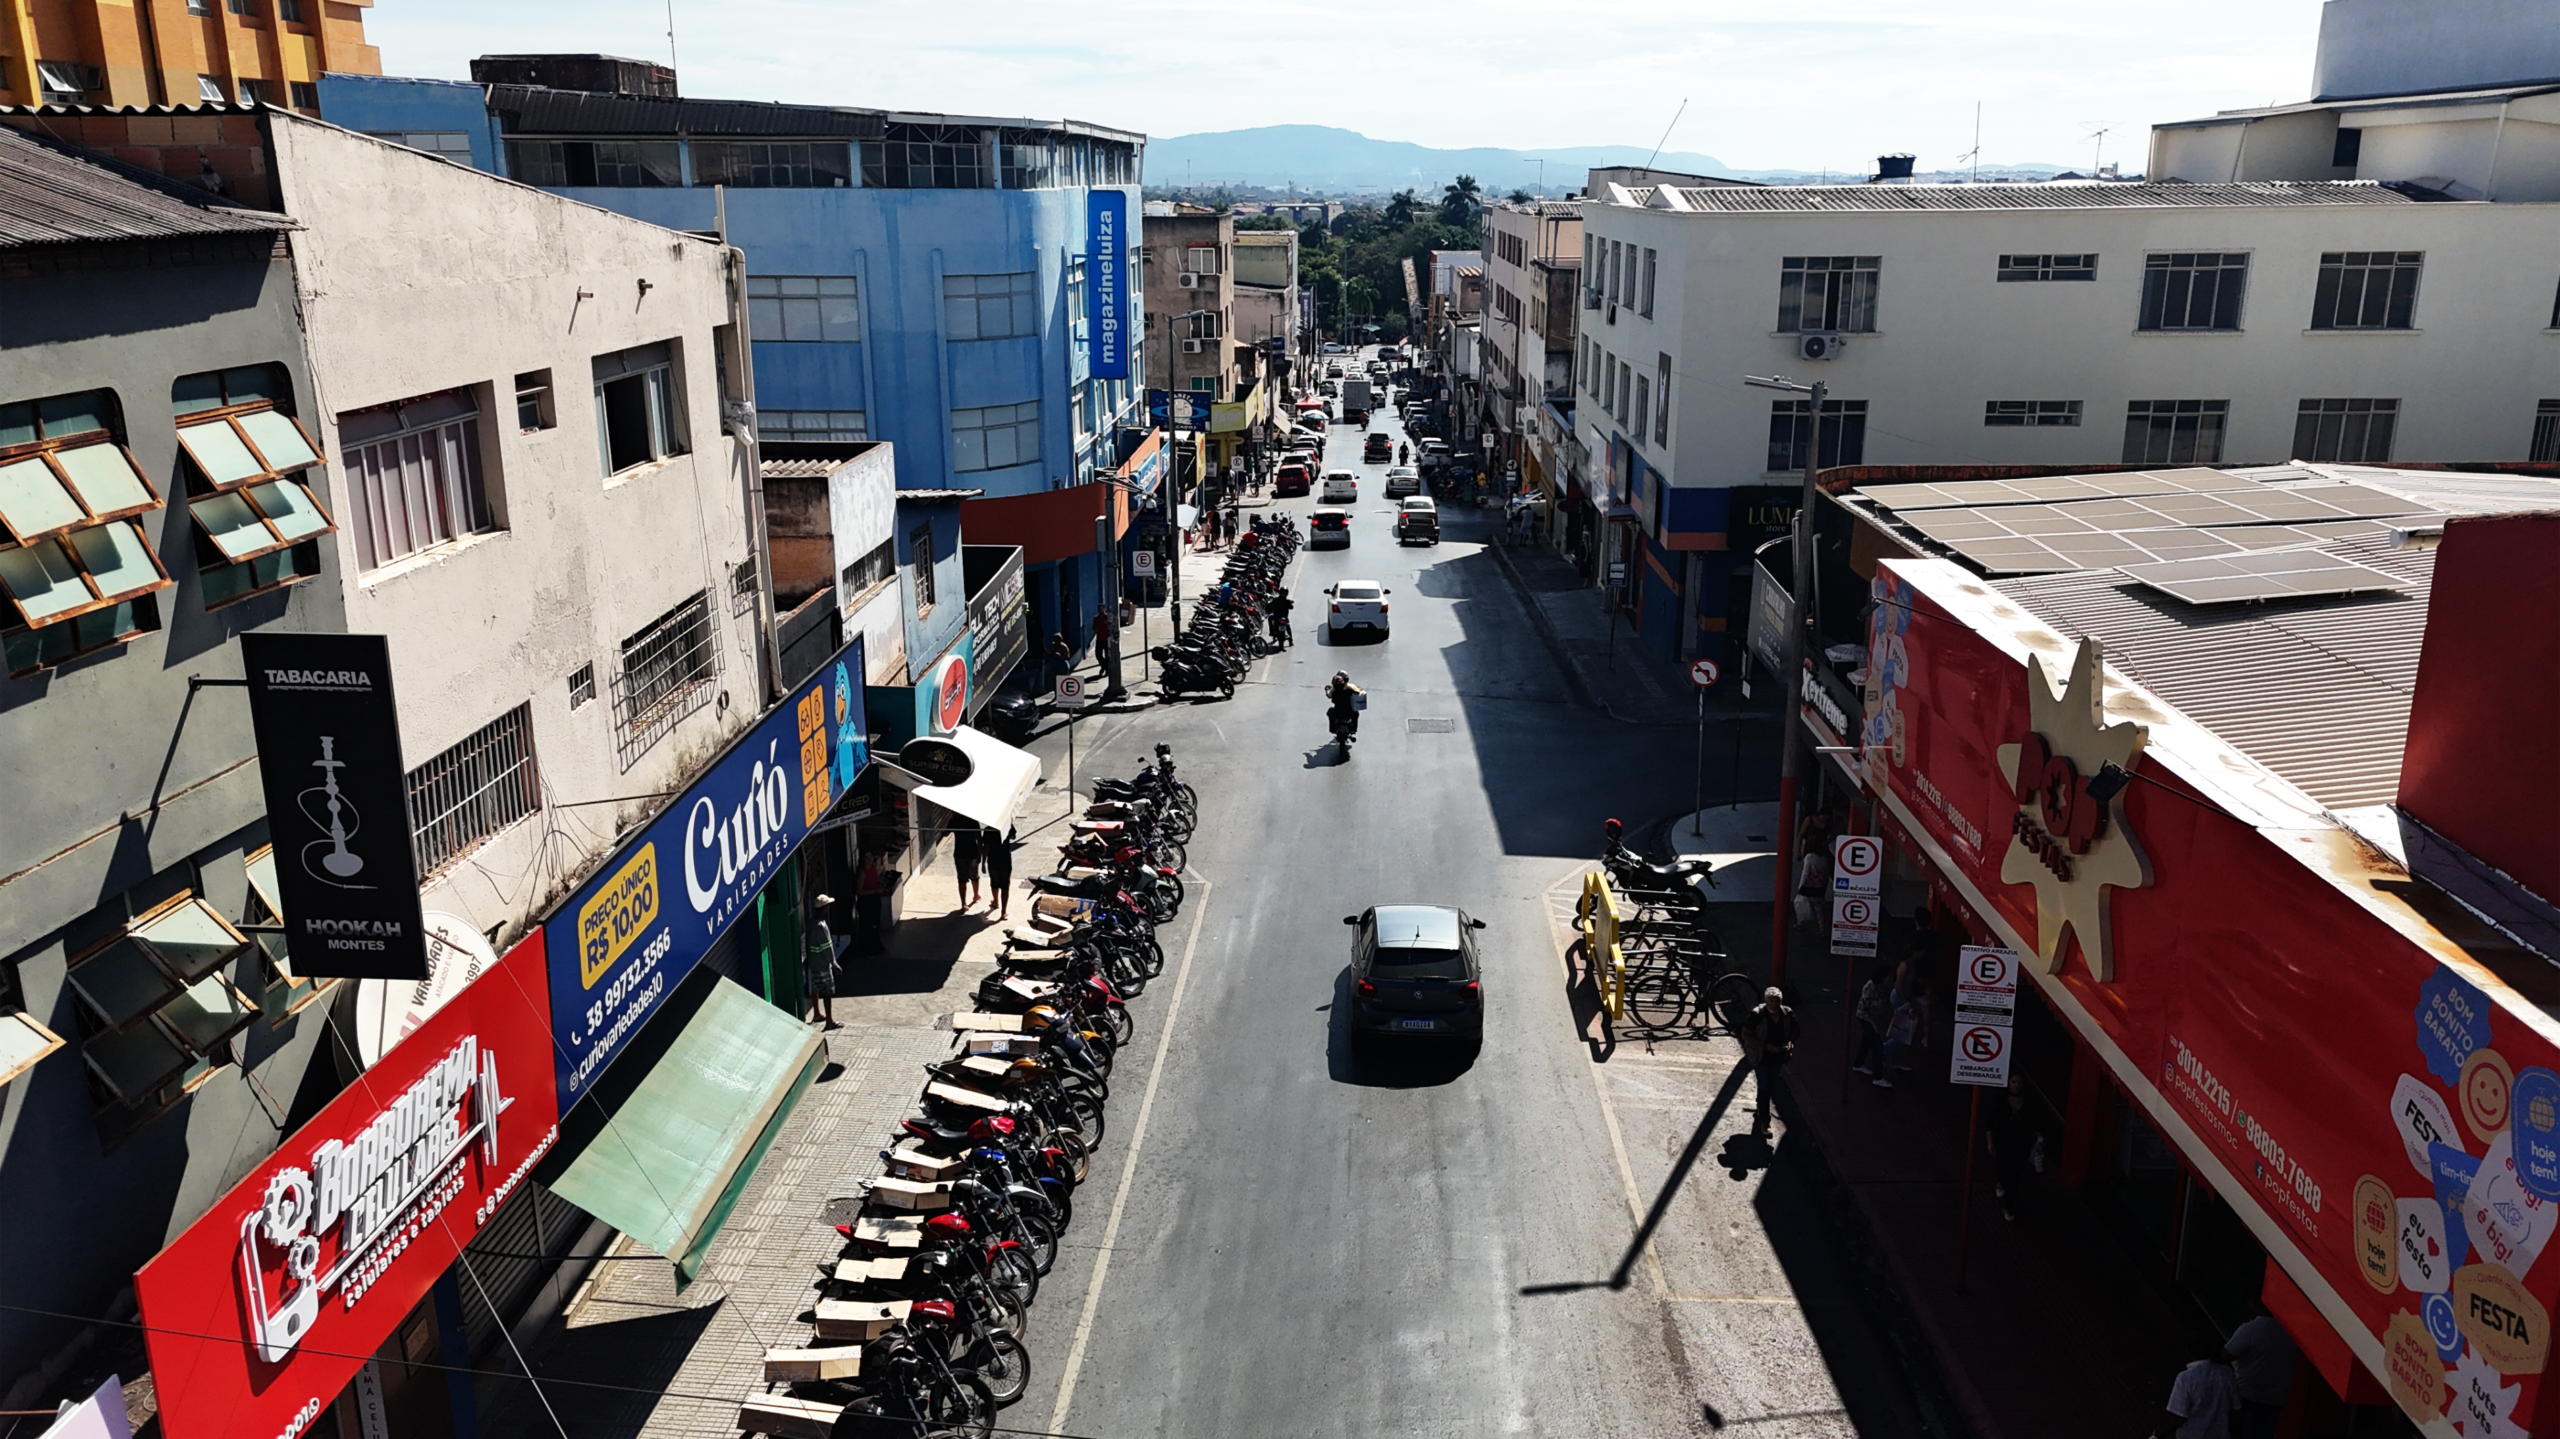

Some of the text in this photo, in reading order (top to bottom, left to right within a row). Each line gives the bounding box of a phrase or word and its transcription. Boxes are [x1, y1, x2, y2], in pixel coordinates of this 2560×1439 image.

[1098, 210, 1118, 364] magazineluiza
[1765, 525, 1787, 533] store
[1141, 556, 1147, 564] E
[984, 591, 1000, 621] TECH
[265, 669, 371, 686] TABACARIA
[1066, 681, 1075, 693] E
[684, 738, 788, 913] Curió
[1851, 846, 1866, 867] E
[585, 858, 651, 940] PREÇO ÚNICO
[706, 833, 789, 935] VARIEDADES
[306, 918, 401, 937] HOOKAH
[586, 882, 653, 975] R$ 10,00
[1850, 905, 1862, 919] E
[328, 939, 385, 951] MONTES
[587, 927, 671, 1036] 38 99732.3566
[1980, 961, 1996, 979] E
[578, 970, 664, 1081] curiovariedades10
[2431, 993, 2473, 1052] BONITO
[2448, 987, 2475, 1026] BOM
[2424, 1010, 2465, 1068] BARATO
[1957, 1071, 2003, 1080] DESEMBARQUE
[1960, 1065, 1994, 1073] EMBARQUE
[314, 1034, 478, 1237] BORBOREMA
[2174, 1075, 2238, 1150] popfestasmoc
[2177, 1041, 2230, 1116] 3014.2215
[2246, 1116, 2322, 1213] 98803.7688
[2405, 1098, 2446, 1146] FEST
[2530, 1161, 2558, 1182] tem!
[2531, 1140, 2556, 1164] hoje
[344, 1102, 461, 1252] CELULARES
[341, 1154, 467, 1295] Assistência técnica
[2264, 1172, 2319, 1238] popfestas
[2409, 1213, 2425, 1238] eu
[345, 1174, 465, 1308] celulares e tablets
[2367, 1238, 2386, 1260] hoje
[2401, 1227, 2431, 1279] festa
[2477, 1208, 2514, 1264] é big!
[2367, 1256, 2386, 1277] tem!
[2470, 1293, 2529, 1345] FESTA
[2394, 1341, 2433, 1388] BONITO
[2405, 1332, 2428, 1363] BOM
[2392, 1358, 2431, 1405] BARATO
[2472, 1377, 2496, 1416] tuts
[2468, 1396, 2492, 1434] tuts
